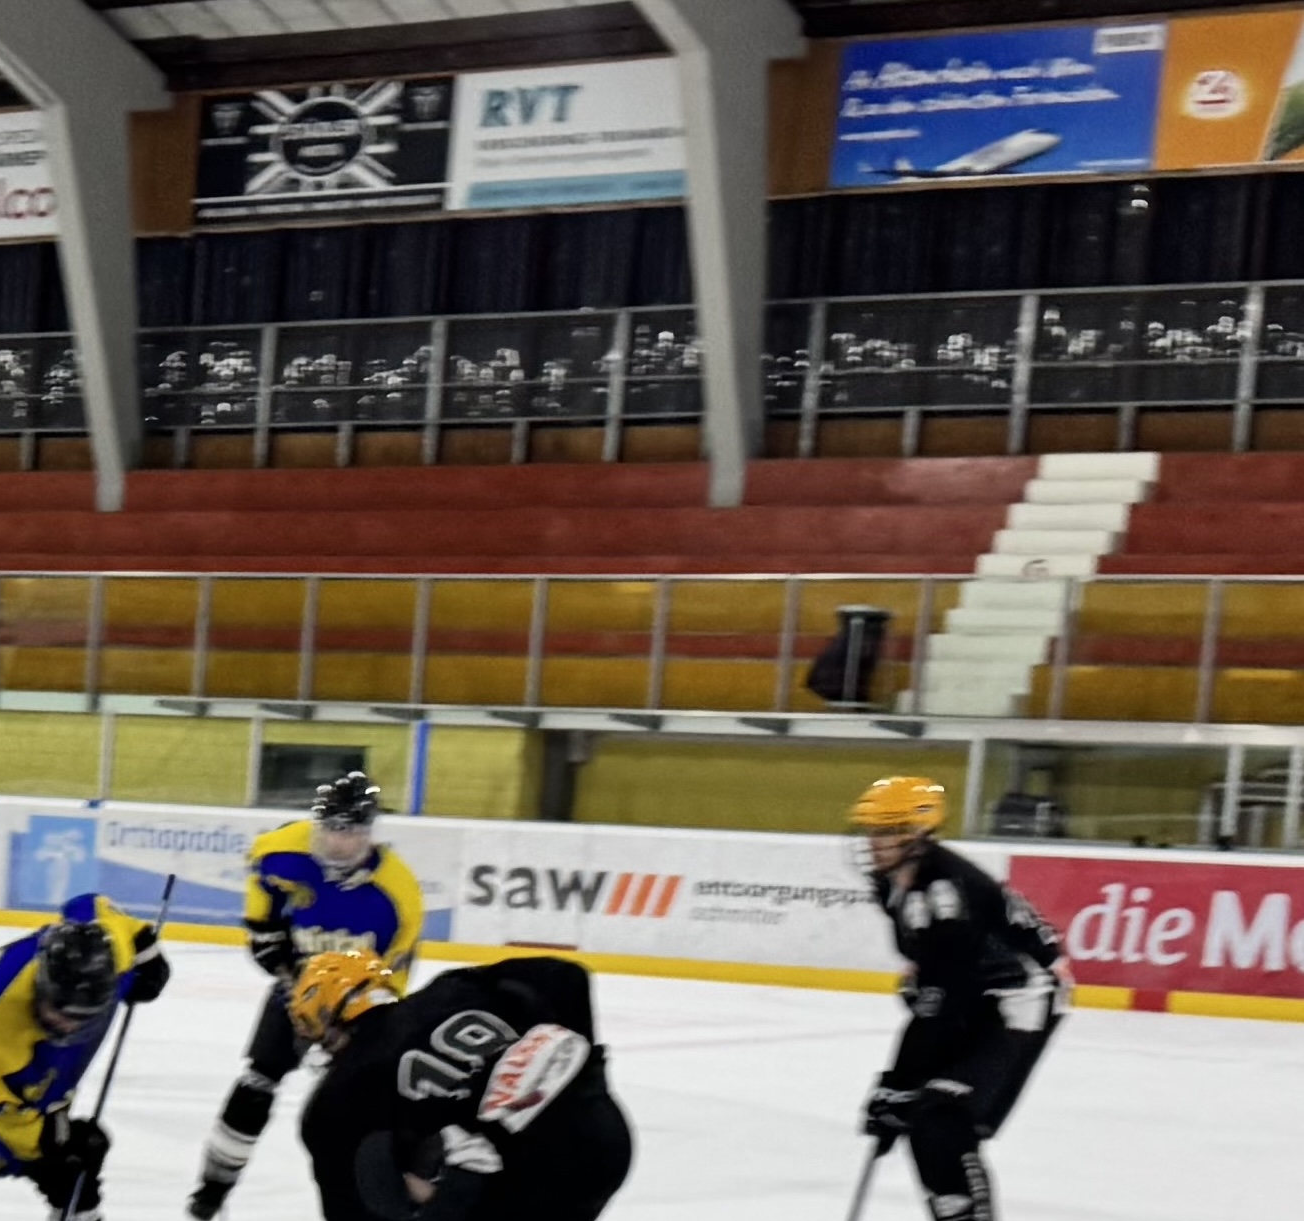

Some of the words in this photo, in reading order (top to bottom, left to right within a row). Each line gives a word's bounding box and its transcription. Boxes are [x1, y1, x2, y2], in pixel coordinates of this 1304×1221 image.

[480, 85, 581, 127] RVT
[470, 863, 607, 913] saw
[1066, 882, 1195, 967] die
